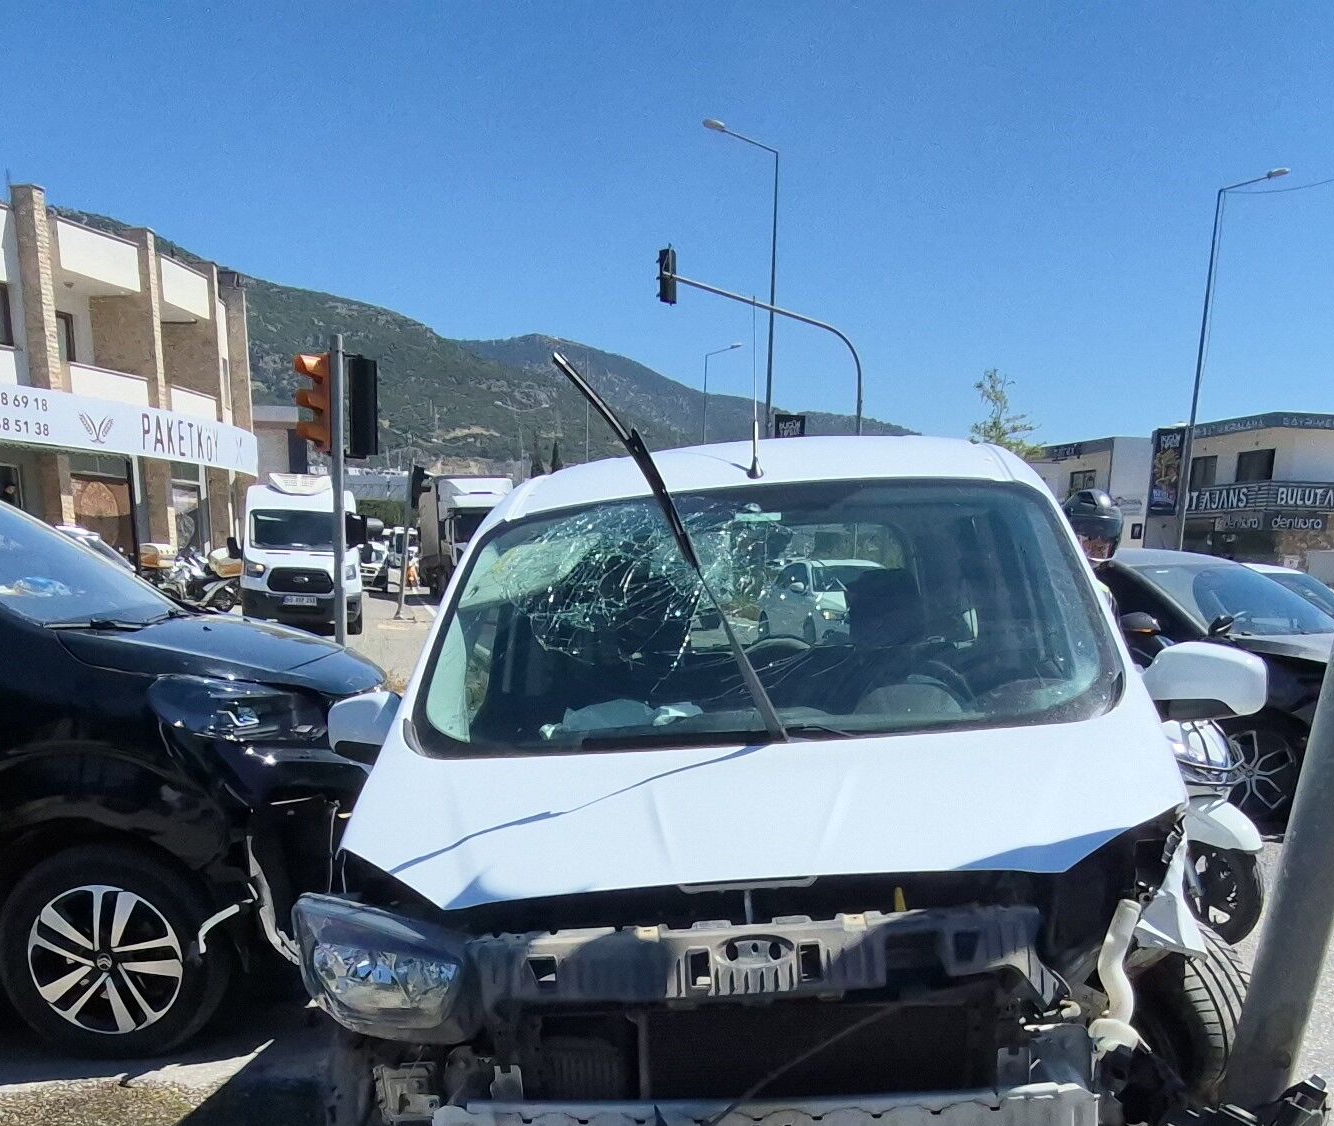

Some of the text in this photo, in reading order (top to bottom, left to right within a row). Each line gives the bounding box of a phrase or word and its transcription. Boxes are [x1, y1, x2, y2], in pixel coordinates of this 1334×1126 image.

[13, 394, 29, 409] 69
[33, 397, 48, 412] 18
[15, 420, 29, 433] 51
[35, 422, 50, 437] 38
[1203, 487, 1247, 509] AJANS
